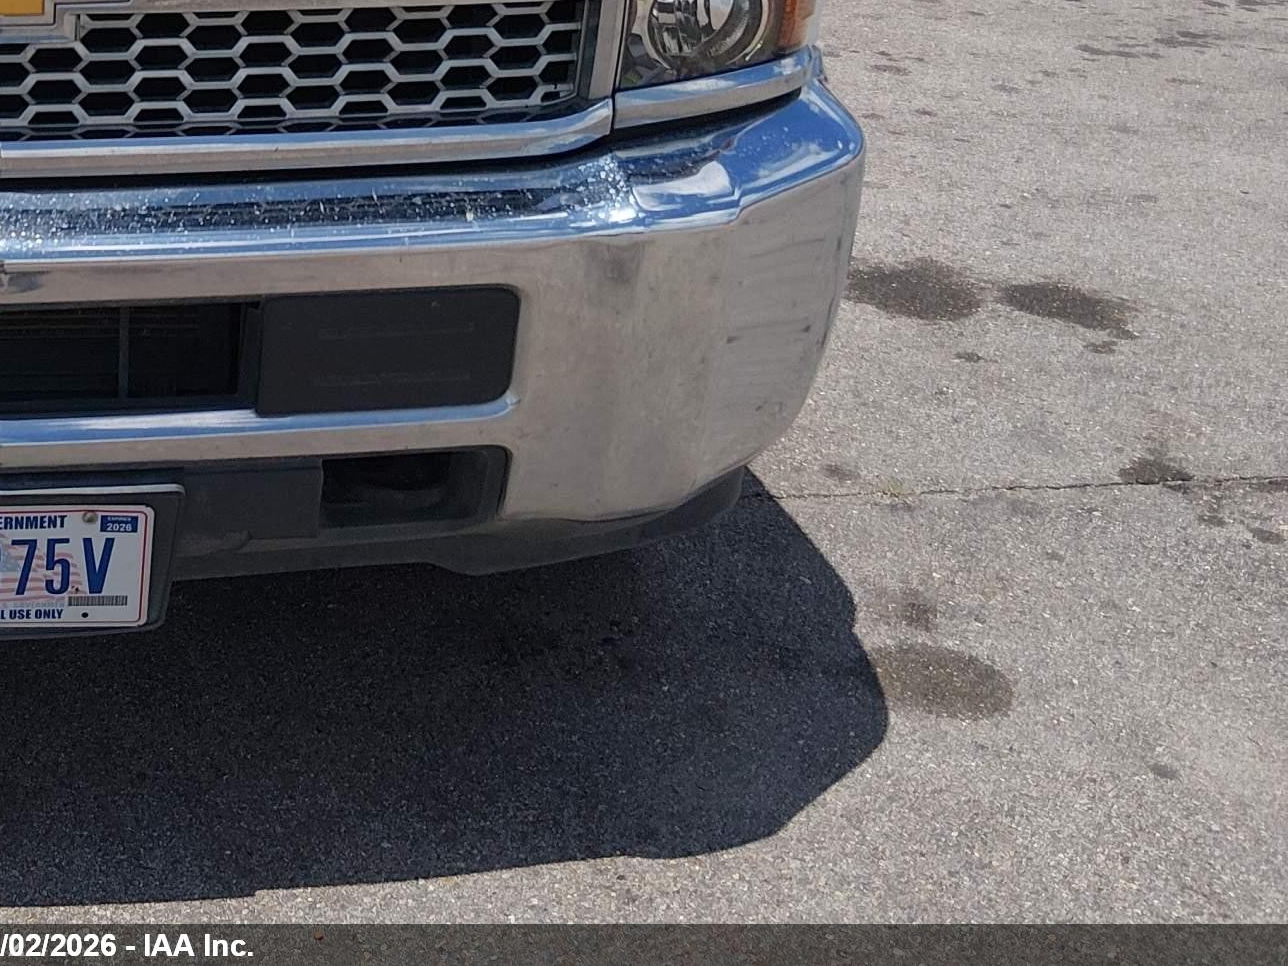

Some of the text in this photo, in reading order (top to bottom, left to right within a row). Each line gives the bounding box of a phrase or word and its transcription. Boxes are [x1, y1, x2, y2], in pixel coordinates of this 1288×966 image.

[106, 522, 133, 532] 2026
[9, 609, 32, 620] USE
[35, 608, 64, 620] ONLY
